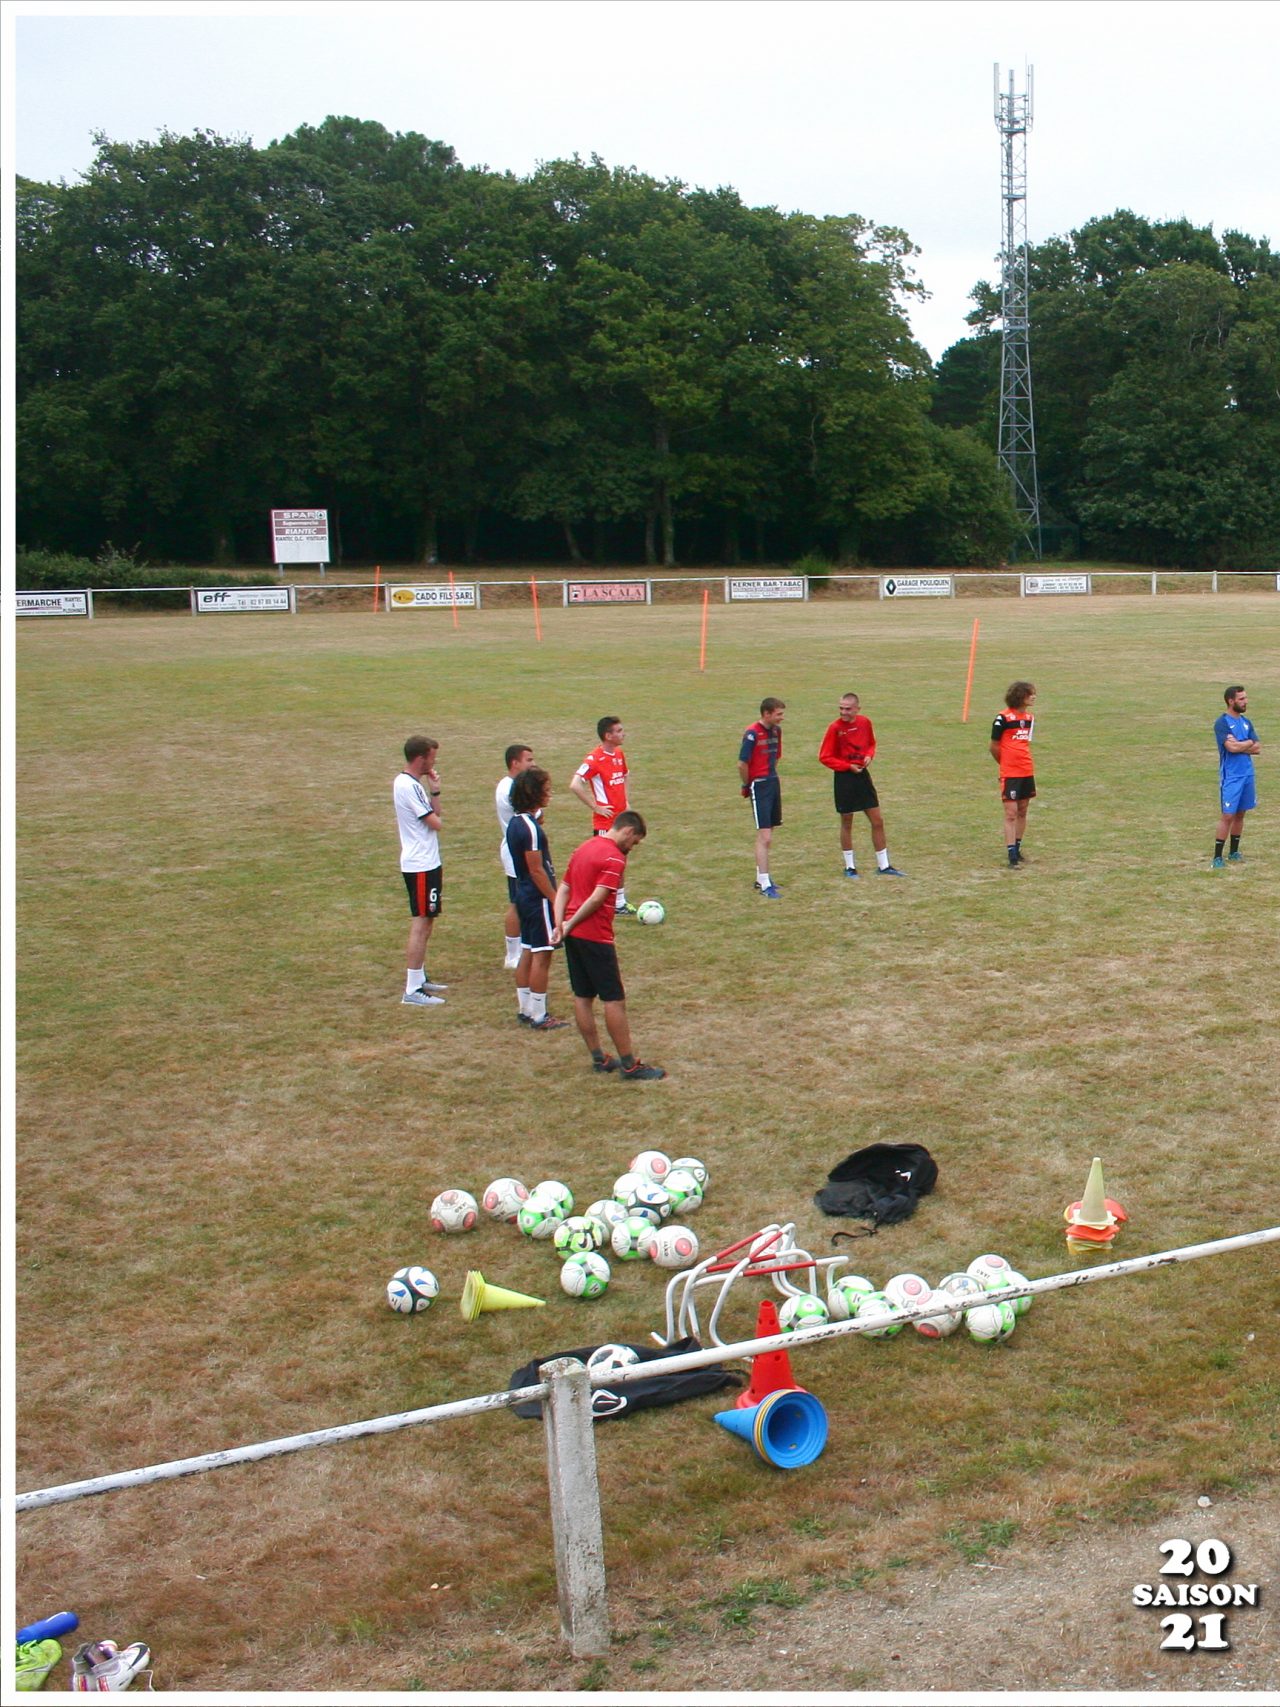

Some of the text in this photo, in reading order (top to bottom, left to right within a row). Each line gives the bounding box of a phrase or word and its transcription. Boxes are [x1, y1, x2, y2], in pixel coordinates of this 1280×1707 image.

[416, 591, 474, 600] CADO FILS SARL
[582, 588, 642, 597] LA SCALA
[430, 888, 437, 902] 6
